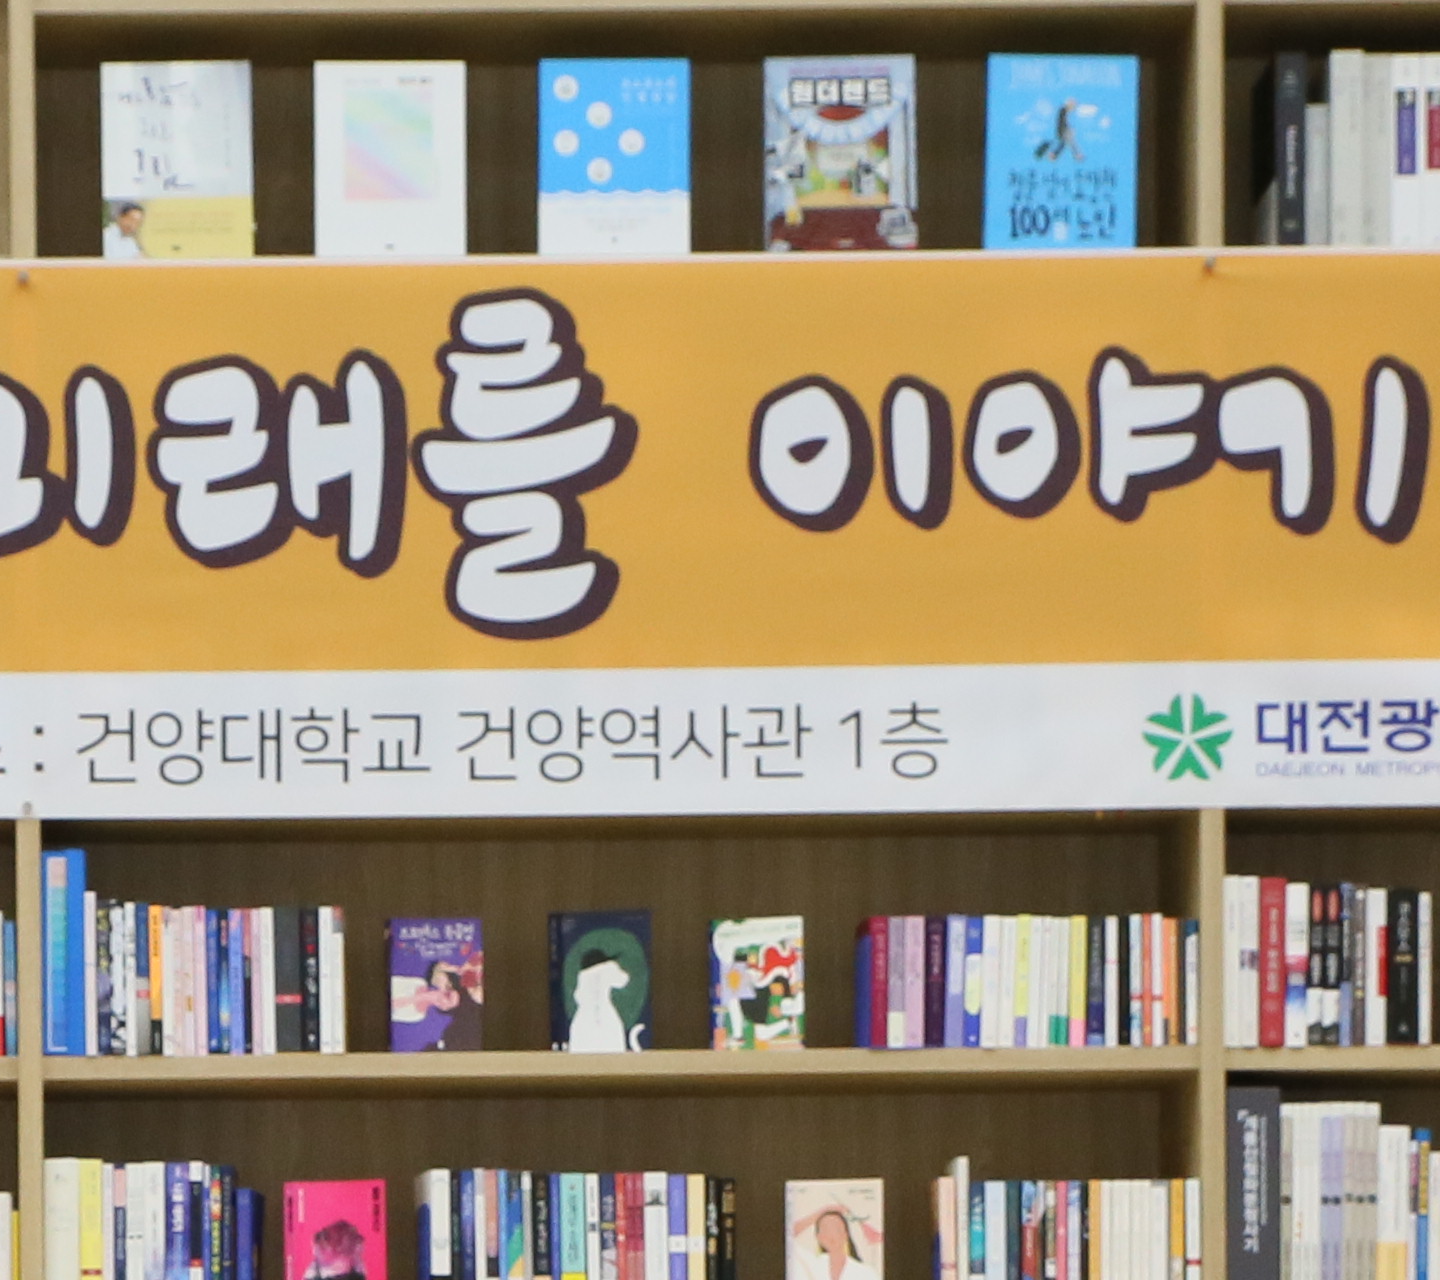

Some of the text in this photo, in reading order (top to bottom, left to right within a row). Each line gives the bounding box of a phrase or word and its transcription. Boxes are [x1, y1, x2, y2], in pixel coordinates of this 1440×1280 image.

[749, 345, 1430, 546] 이야기
[73, 704, 433, 785] 건양대학교
[454, 701, 813, 783] 건양역사관
[836, 701, 952, 780] 1층
[1255, 761, 1346, 778] DAEJEON
